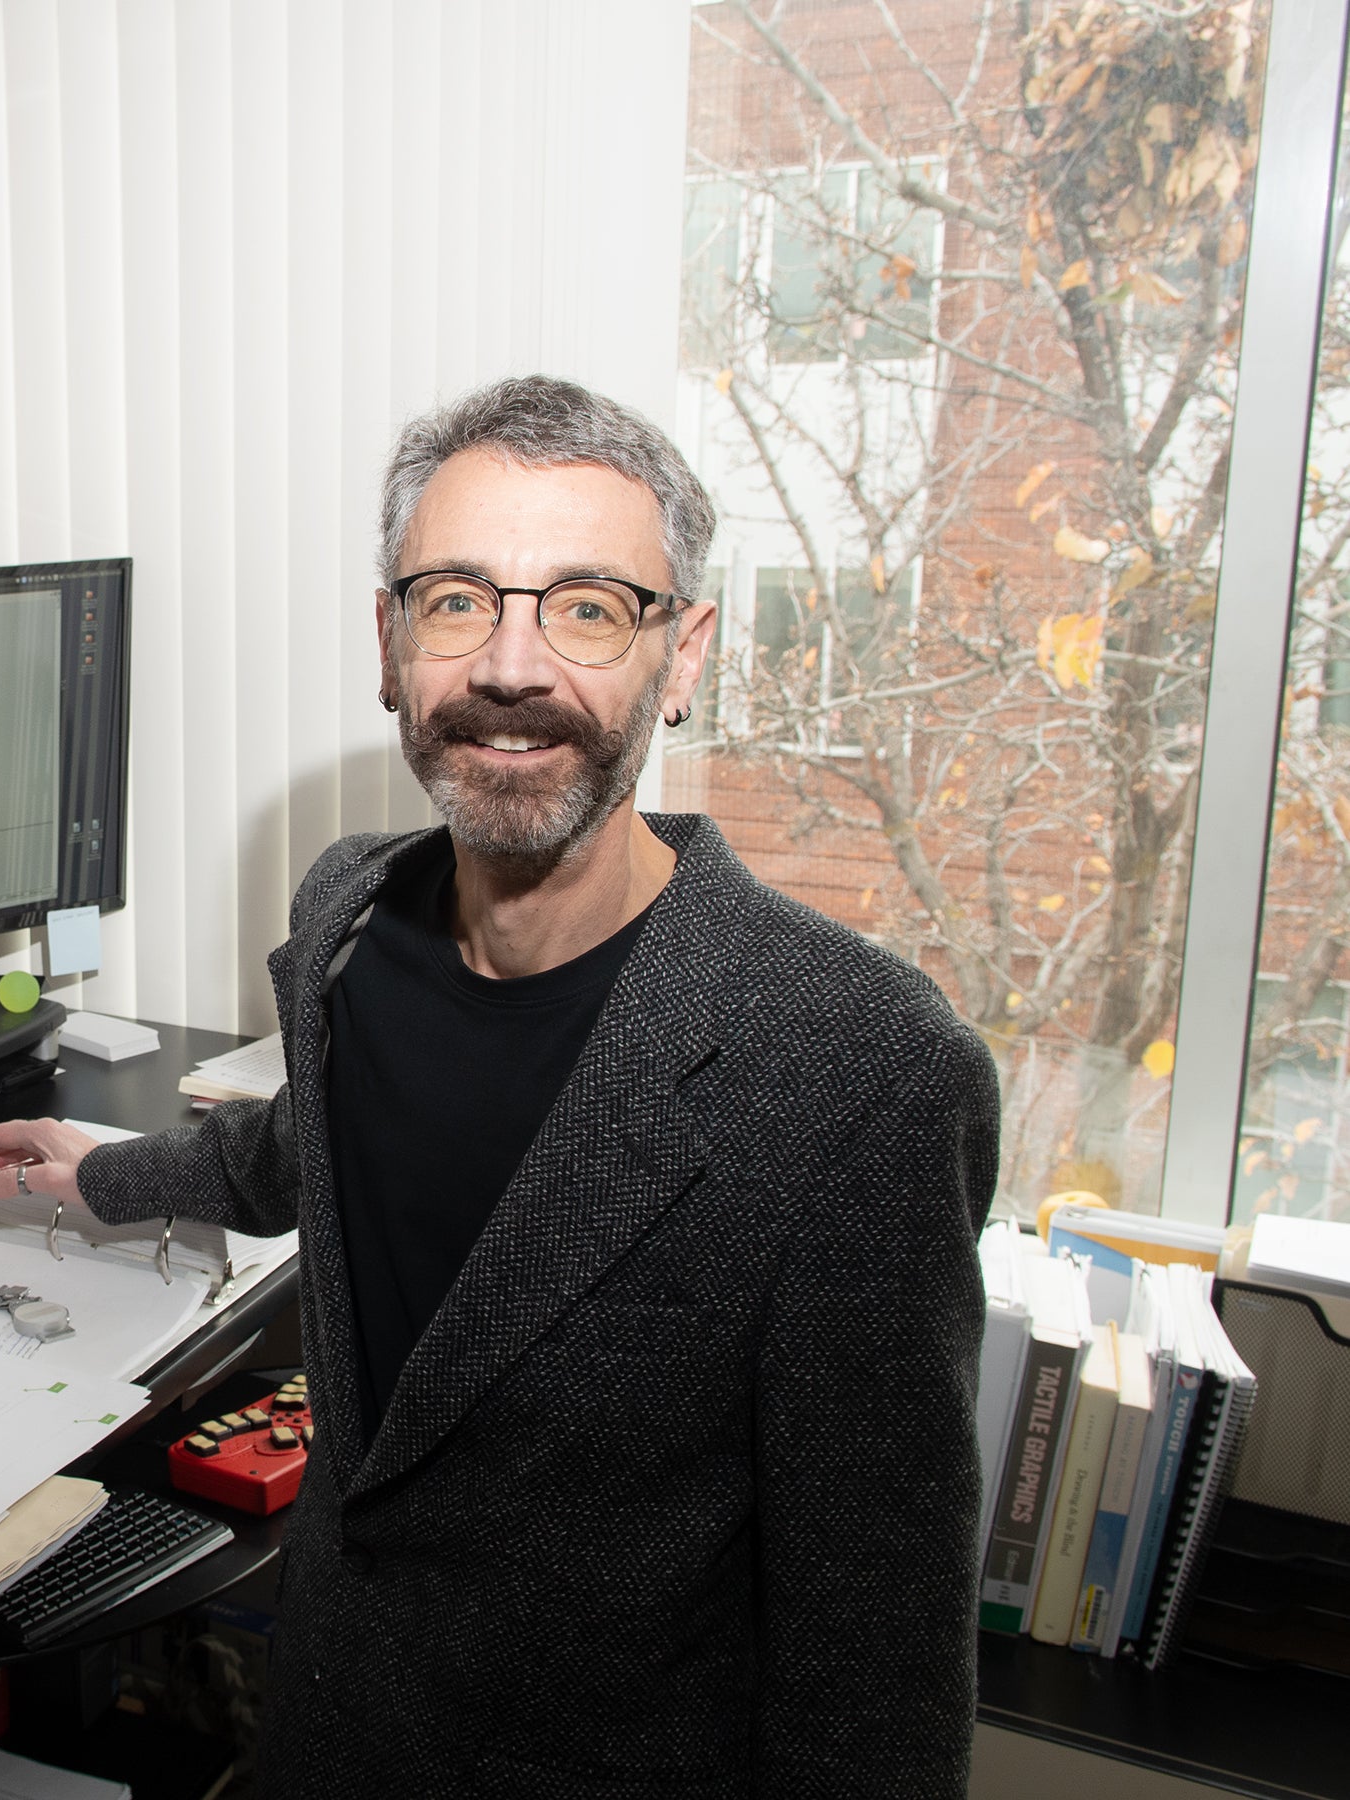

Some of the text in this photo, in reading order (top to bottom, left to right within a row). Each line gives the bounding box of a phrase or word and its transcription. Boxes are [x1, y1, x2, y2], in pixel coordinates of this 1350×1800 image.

[1010, 1366, 1062, 1524] TACTILE GRAPHICS
[1167, 1397, 1189, 1453] TOUCH
